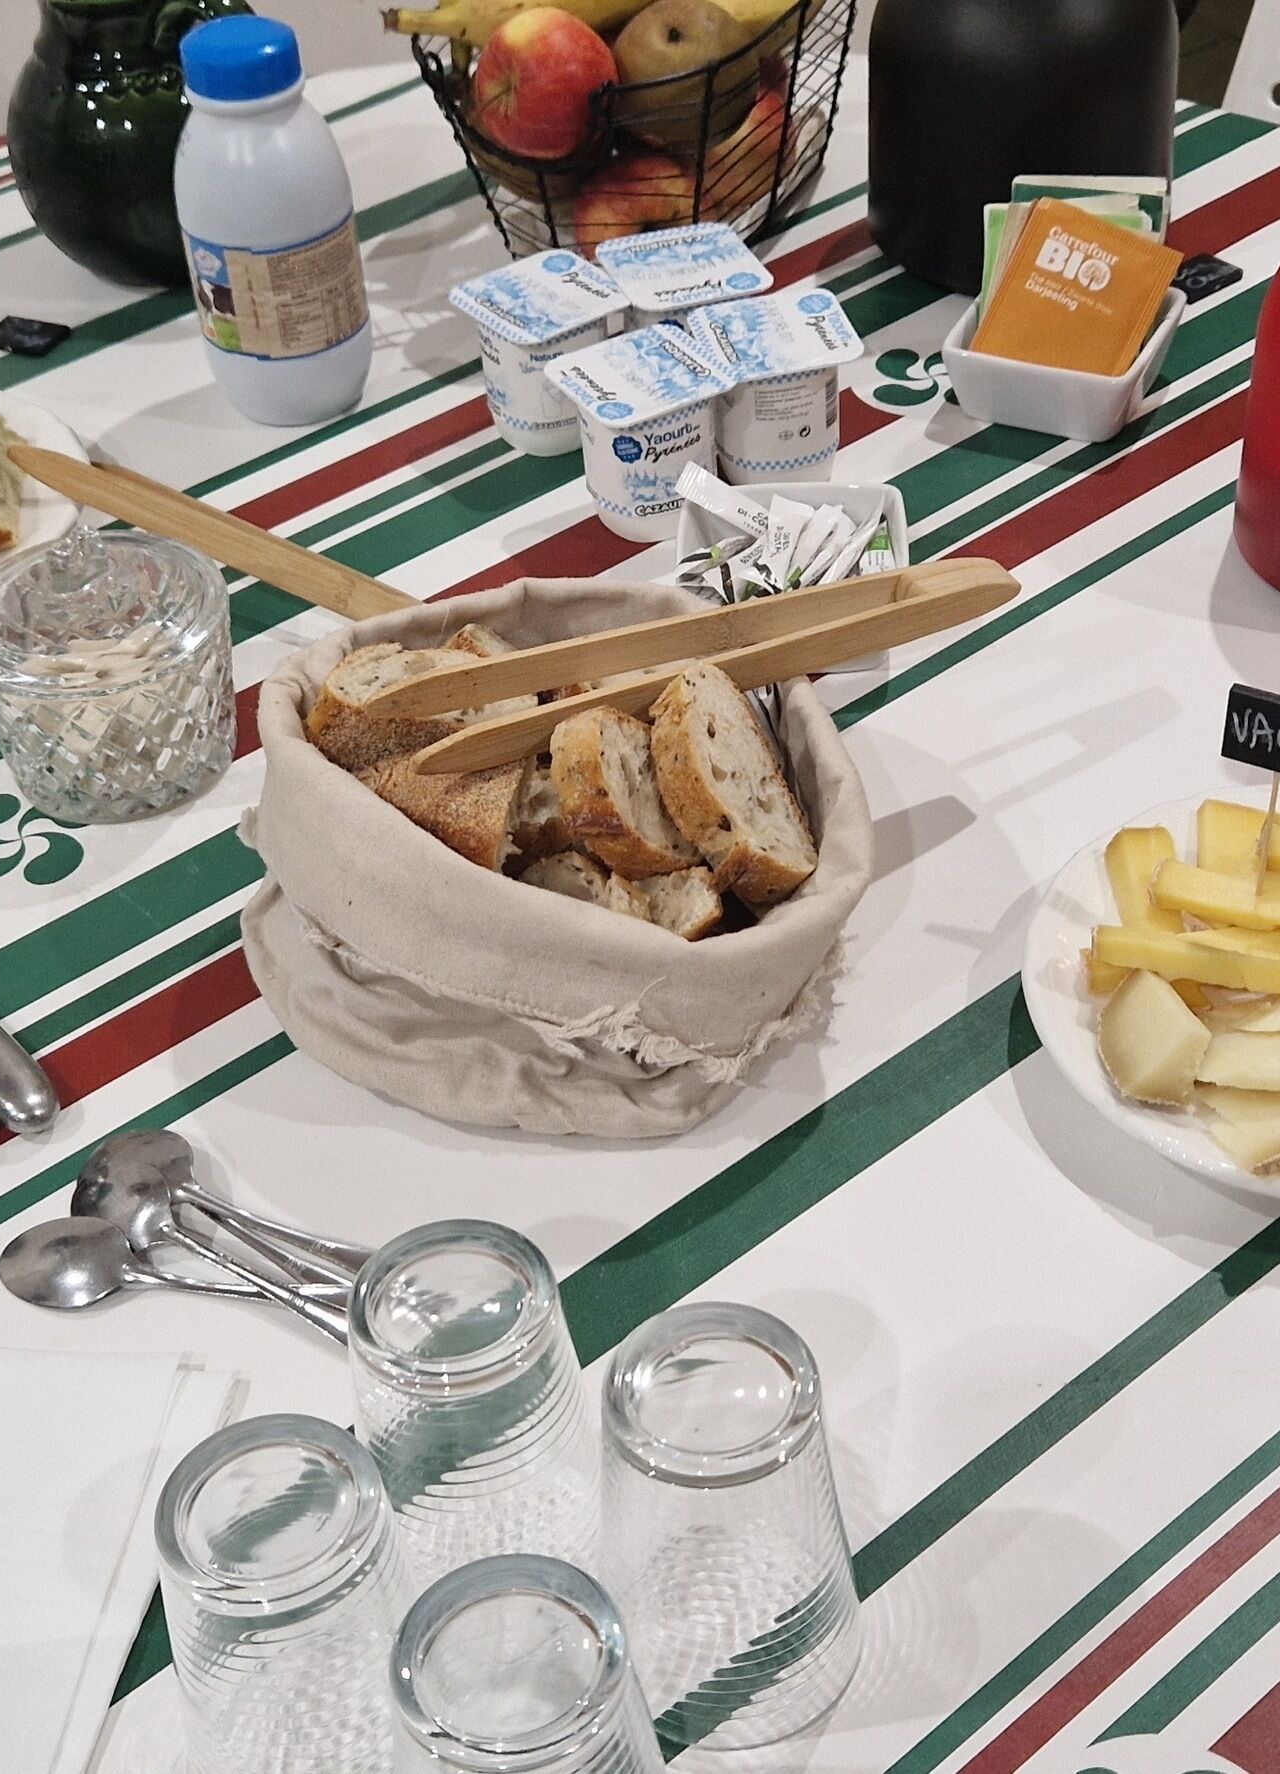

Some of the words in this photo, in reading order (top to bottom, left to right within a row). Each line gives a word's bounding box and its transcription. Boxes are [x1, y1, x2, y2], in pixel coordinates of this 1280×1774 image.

[1050, 225, 1119, 266] Carrefour
[1035, 238, 1111, 291] BIO
[1025, 280, 1078, 311] Darjeeling
[643, 422, 693, 446] Yaourt
[644, 433, 701, 463] Pyrénées
